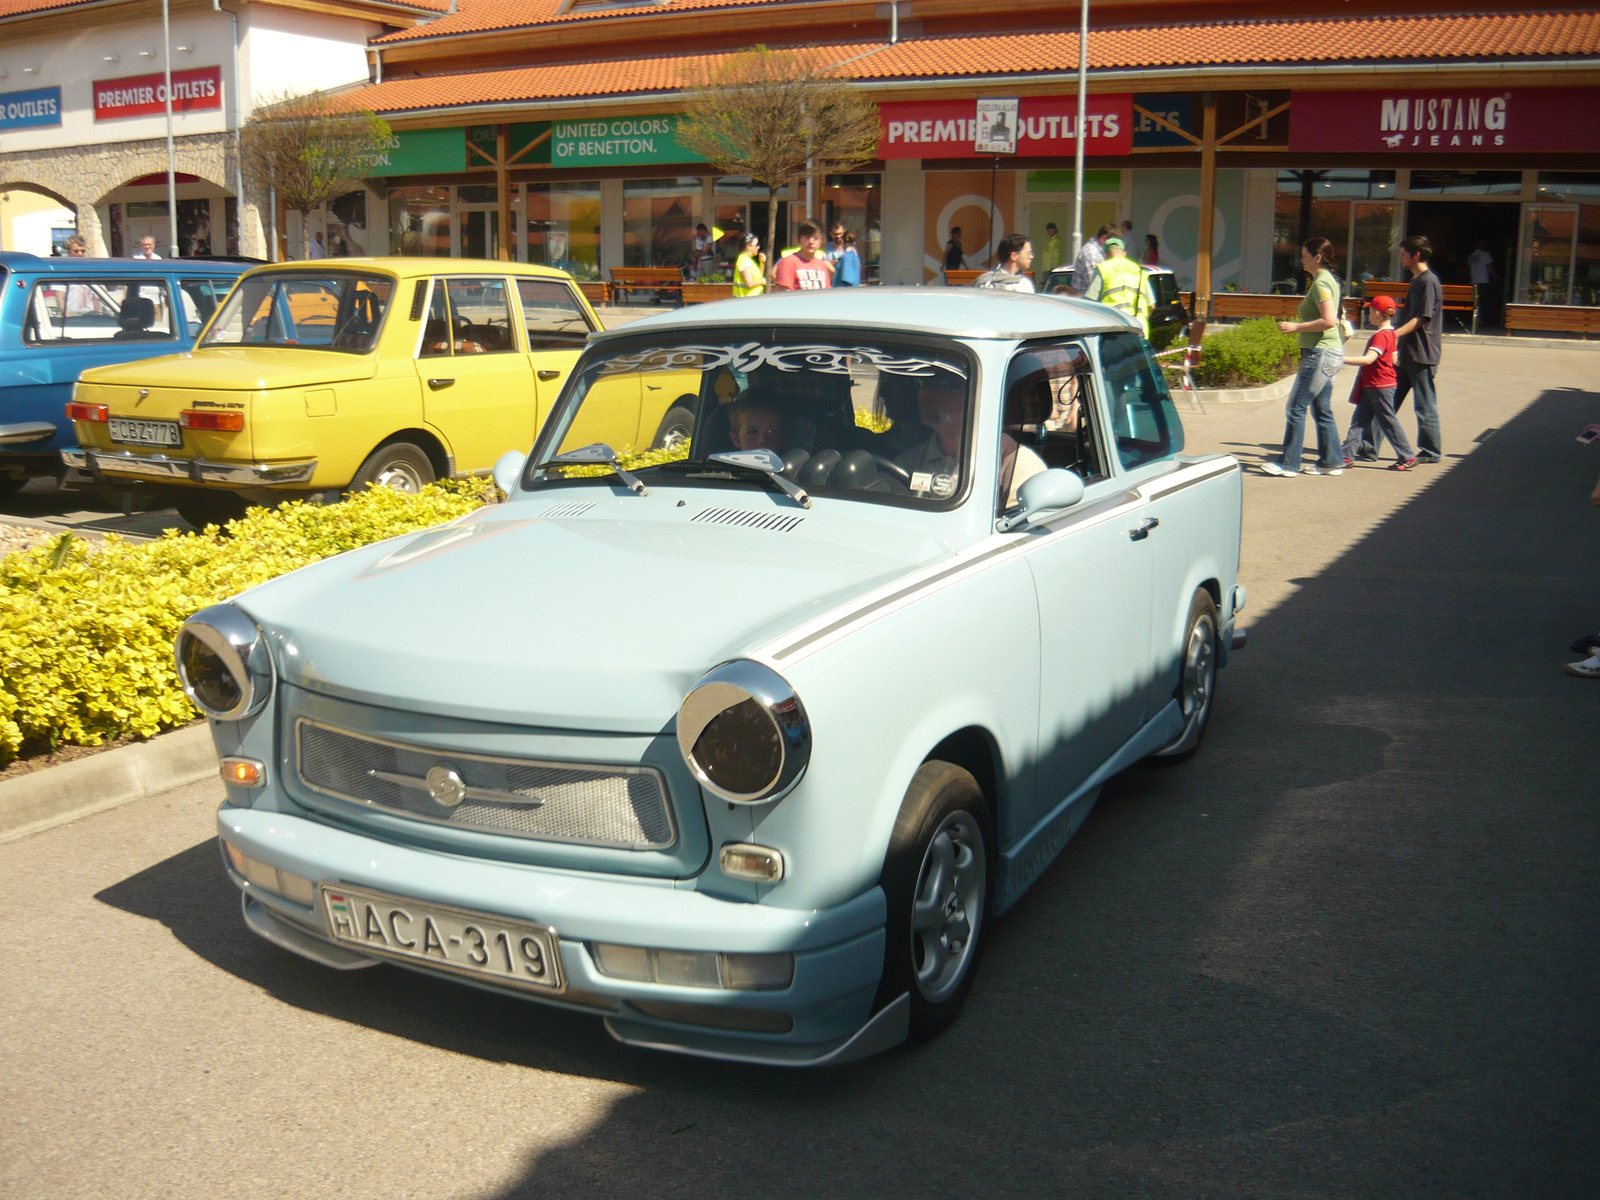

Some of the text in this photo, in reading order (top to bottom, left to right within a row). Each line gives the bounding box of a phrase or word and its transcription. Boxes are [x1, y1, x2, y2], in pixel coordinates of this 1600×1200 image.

[156, 79, 216, 102] OUTLETS
[7, 98, 58, 118] OUTLETS
[1380, 97, 1507, 131] MUSTANG
[556, 119, 670, 139] UNITED COLORS
[888, 118, 977, 144] PREMIE
[556, 139, 658, 157] OF BENETTON.
[1411, 134, 1505, 147] JEANS
[365, 902, 548, 976] ACA-319
